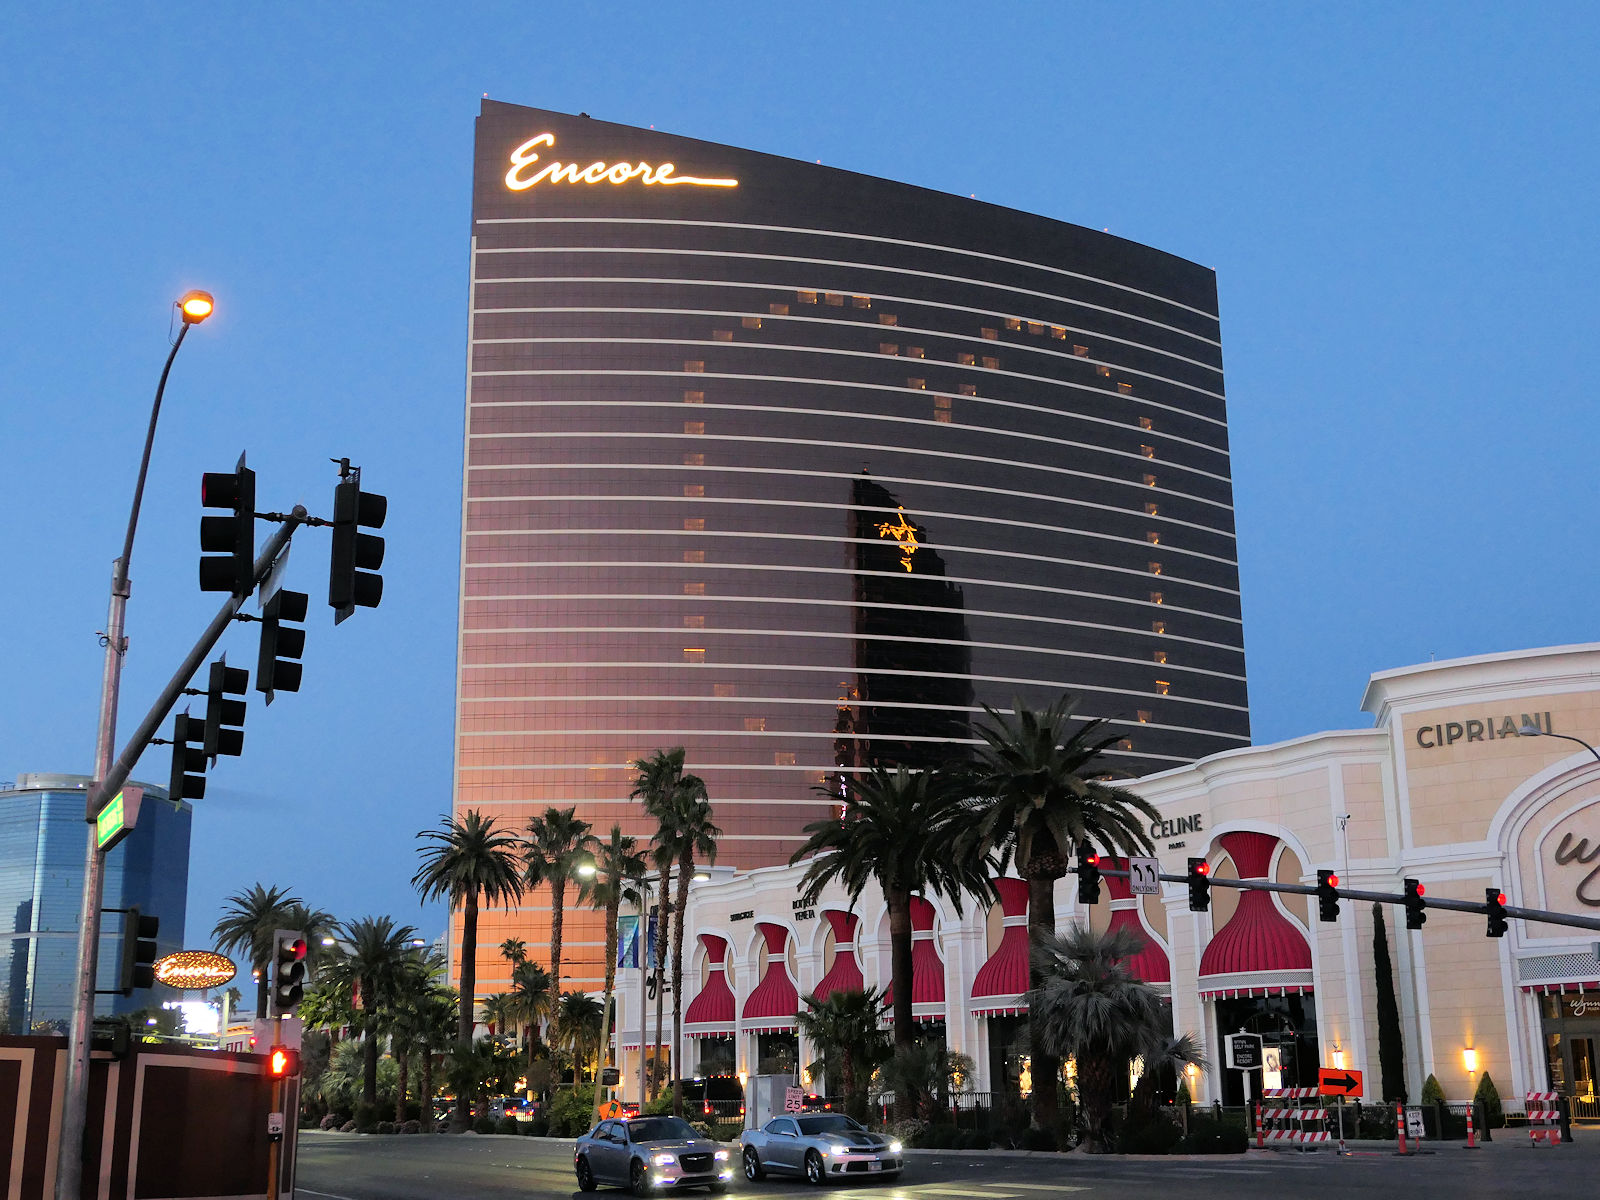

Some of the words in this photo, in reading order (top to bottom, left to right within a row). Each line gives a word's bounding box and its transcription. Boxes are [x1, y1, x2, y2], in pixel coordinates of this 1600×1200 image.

[505, 132, 739, 191] Encore
[1416, 711, 1552, 748] CIPRIANI
[1150, 813, 1203, 840] CELINE
[1132, 885, 1146, 893] ONLY
[1146, 885, 1158, 893] ONLY
[157, 957, 235, 978] Encore
[786, 1099, 801, 1110] 25
